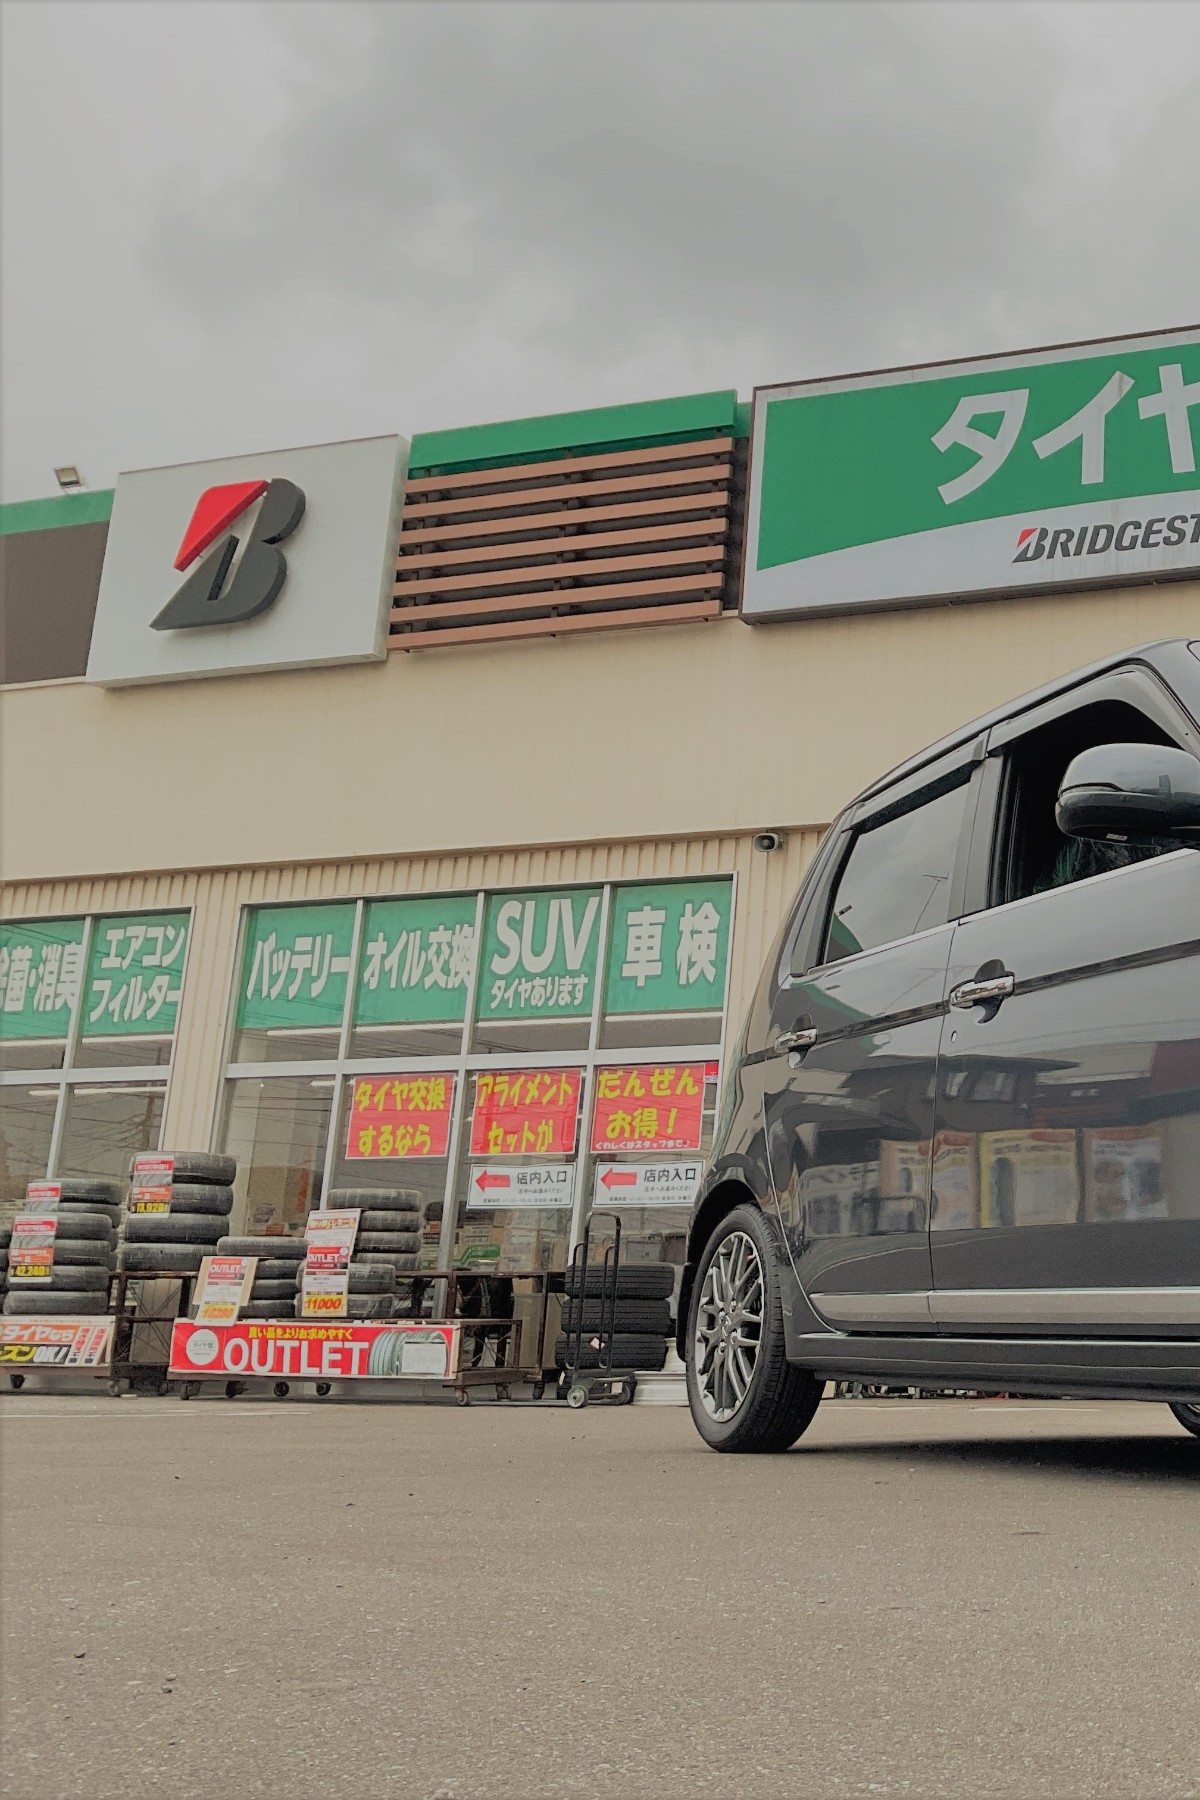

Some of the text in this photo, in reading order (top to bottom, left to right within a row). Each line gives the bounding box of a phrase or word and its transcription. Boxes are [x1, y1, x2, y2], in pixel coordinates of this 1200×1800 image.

[100, 925, 186, 970] エアコン
[490, 897, 600, 974] SUV
[622, 902, 720, 987] 車検
[247, 932, 349, 1000] バッテリー
[363, 923, 475, 990] オイル交換
[90, 976, 182, 1023] フィルター
[490, 974, 588, 1009] タイヤあります
[354, 1077, 445, 1112] タイヤ交換
[478, 1073, 573, 1107] アライメント
[598, 1067, 699, 1099] だんぜん
[358, 1123, 431, 1157] するなら
[488, 1119, 553, 1154] セットが
[517, 1170, 568, 1185] 店内入口
[643, 1167, 697, 1183] 店内入口
[0, 1325, 74, 1342] タイヤなら
[224, 1338, 369, 1375] OUTLET
